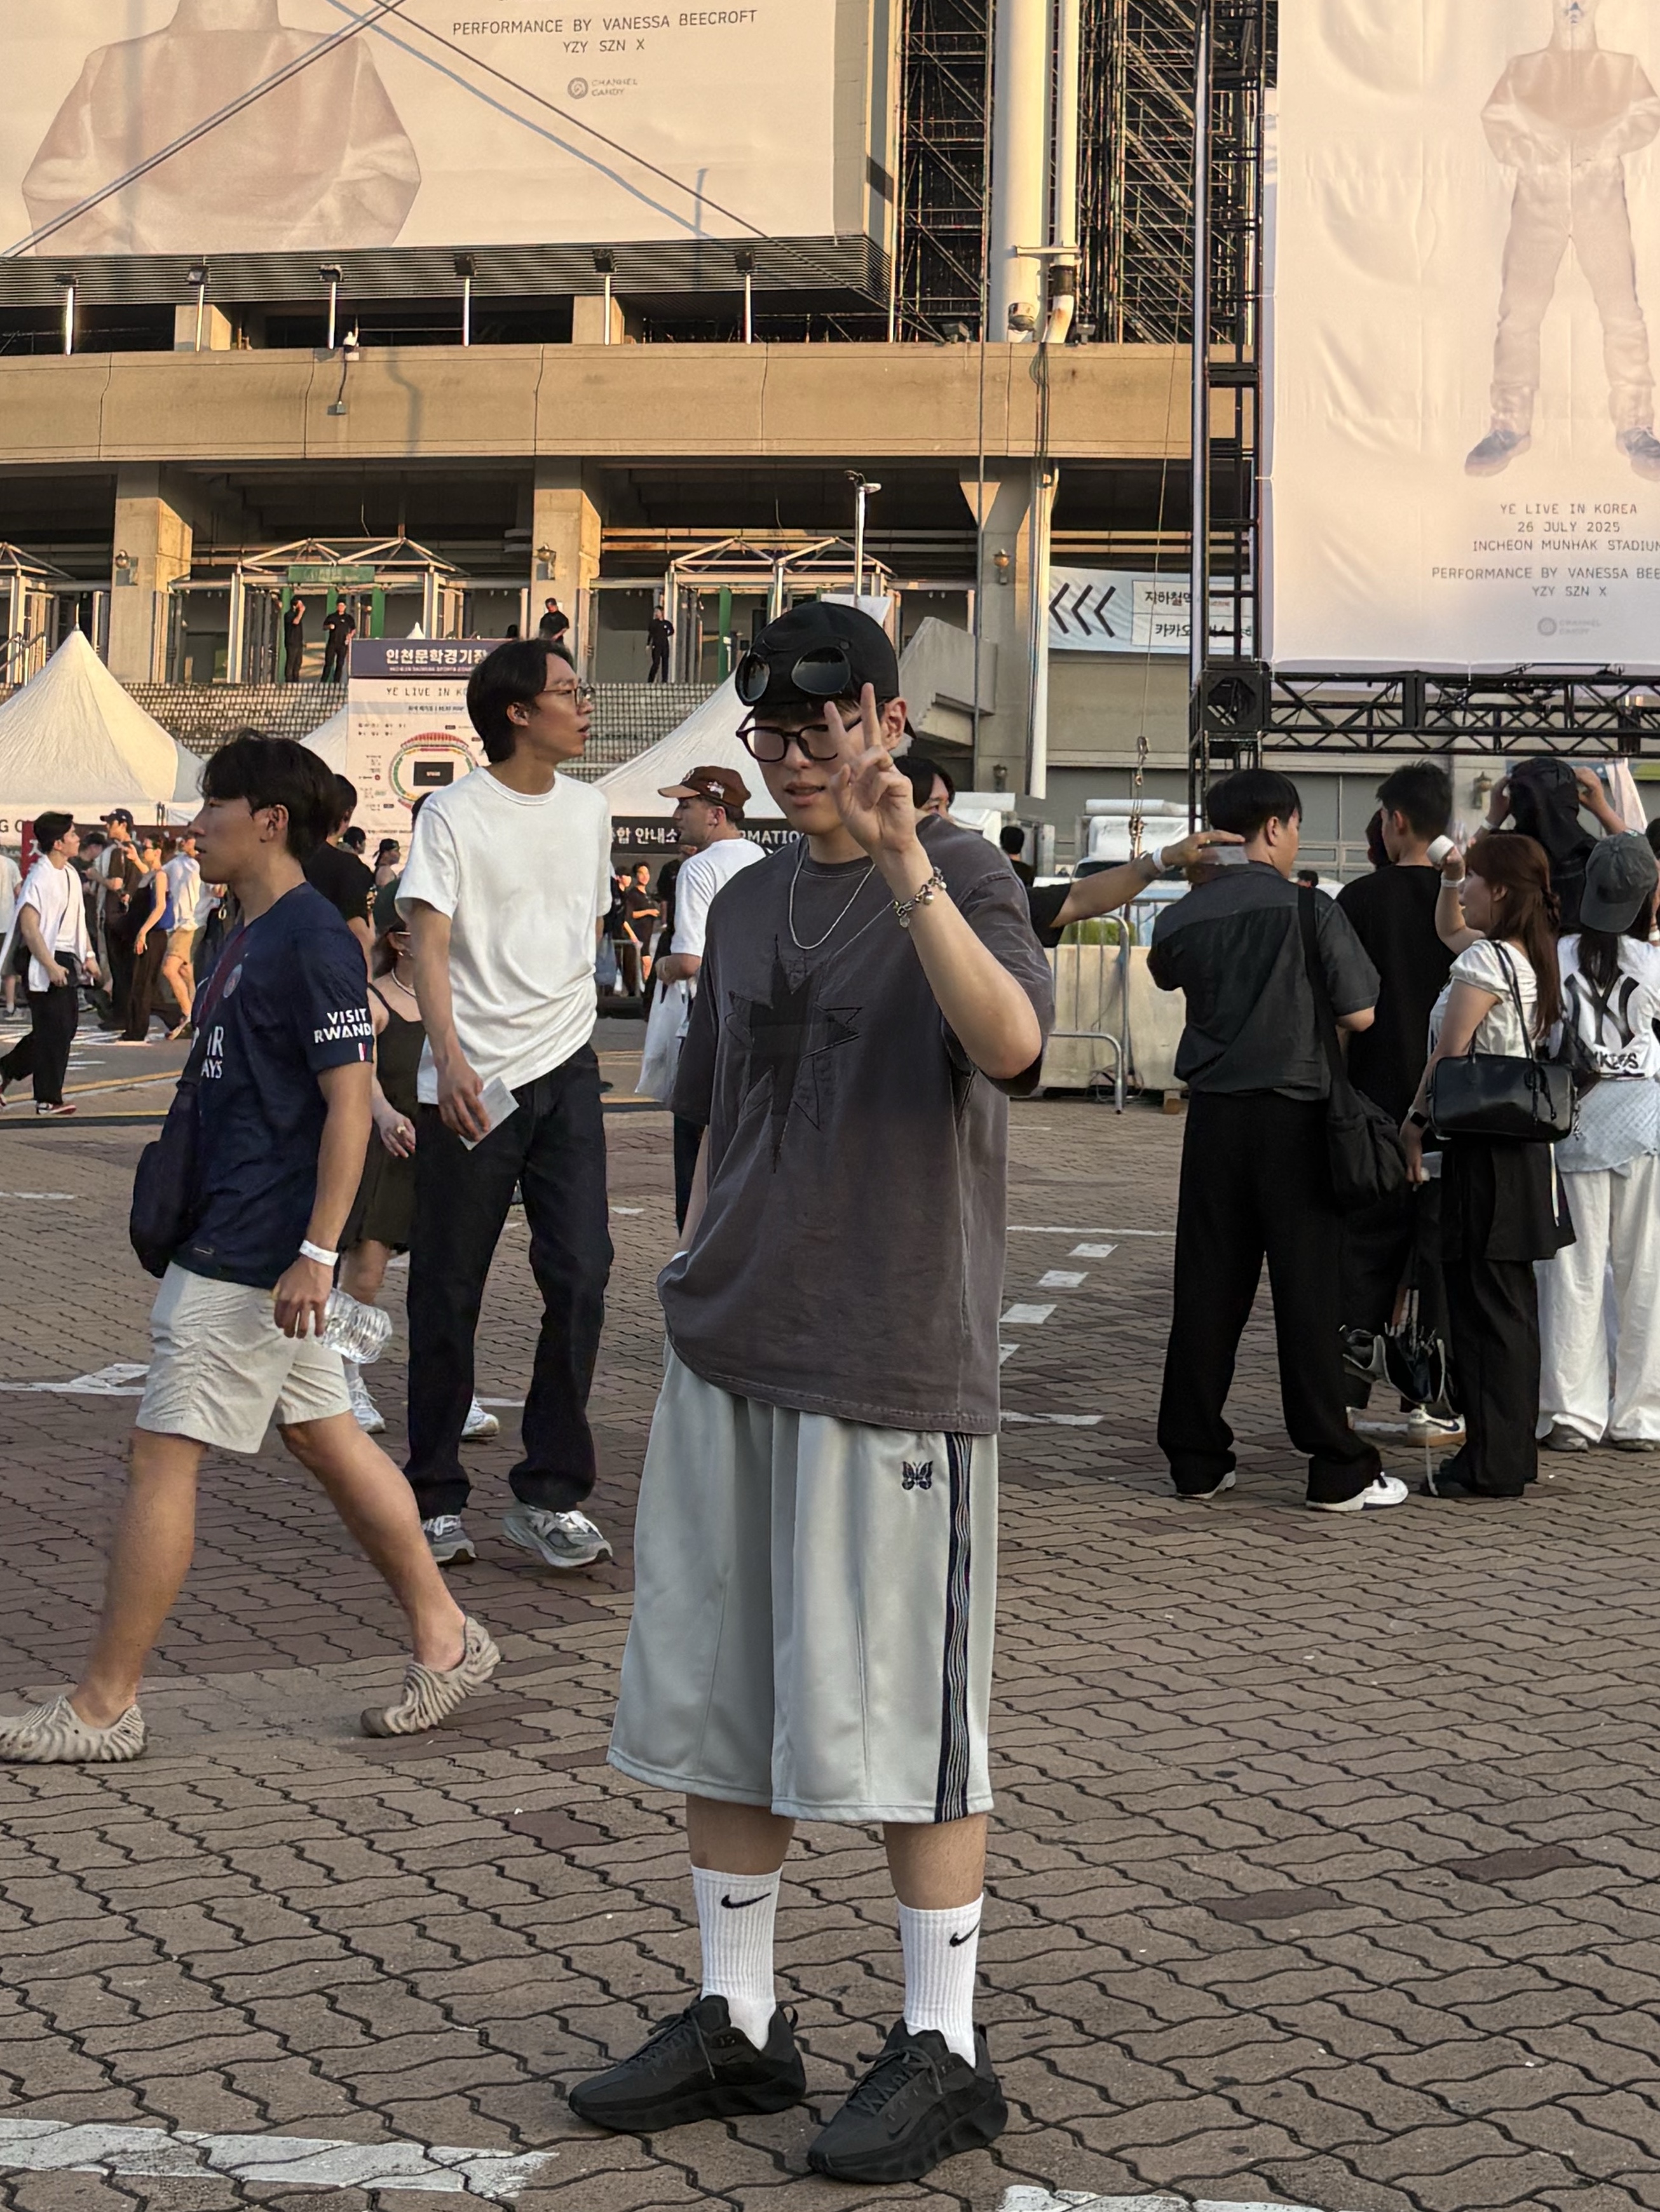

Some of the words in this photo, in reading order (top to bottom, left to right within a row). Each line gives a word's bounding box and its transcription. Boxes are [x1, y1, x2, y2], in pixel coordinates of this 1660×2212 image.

[452, 19, 563, 35] PERFORMANCE
[573, 18, 592, 32] BY
[602, 15, 670, 31] VANESSA
[679, 10, 758, 26] BEECROFT
[563, 41, 588, 53] YZY
[599, 39, 626, 52] SZN
[636, 38, 644, 50] X
[1500, 504, 1516, 515] YE
[1525, 504, 1559, 515] LIVE
[1570, 504, 1586, 515] IN
[1595, 504, 1638, 515] KOREA
[1518, 522, 1534, 533] 26
[1544, 522, 1577, 533] JULY
[1587, 522, 1620, 533] 2025
[1473, 539, 1533, 552] INCHEON
[1541, 539, 1598, 552] MUNHAK
[1432, 567, 1533, 580] PERFORMANCE
[1541, 567, 1558, 579] BY
[1568, 567, 1629, 579] VANESSA
[1532, 586, 1556, 597] YZY
[1565, 586, 1589, 597] SZN
[1599, 586, 1607, 597] X
[386, 688, 398, 696] YE
[405, 688, 430, 696] LIVE
[438, 688, 450, 696] IN
[635, 827, 678, 845] 안내소
[327, 1008, 367, 1024] VISIT
